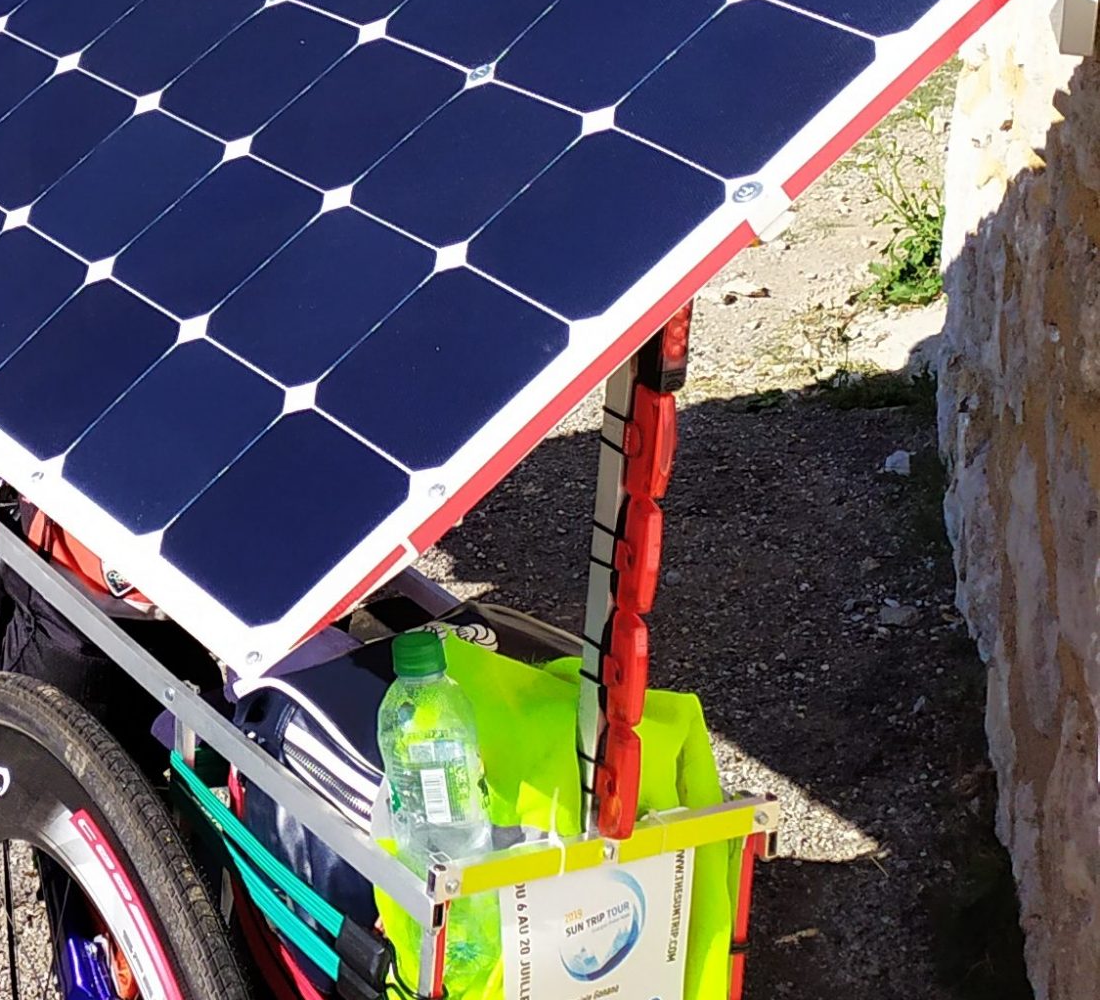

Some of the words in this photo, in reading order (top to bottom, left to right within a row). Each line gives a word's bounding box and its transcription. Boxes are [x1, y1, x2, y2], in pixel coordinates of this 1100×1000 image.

[517, 903, 528, 912] 6
[517, 916, 529, 935] AU
[565, 922, 584, 938] SUN
[586, 912, 605, 928] TRIP
[606, 901, 630, 919] TOUR
[519, 938, 531, 956] 20
